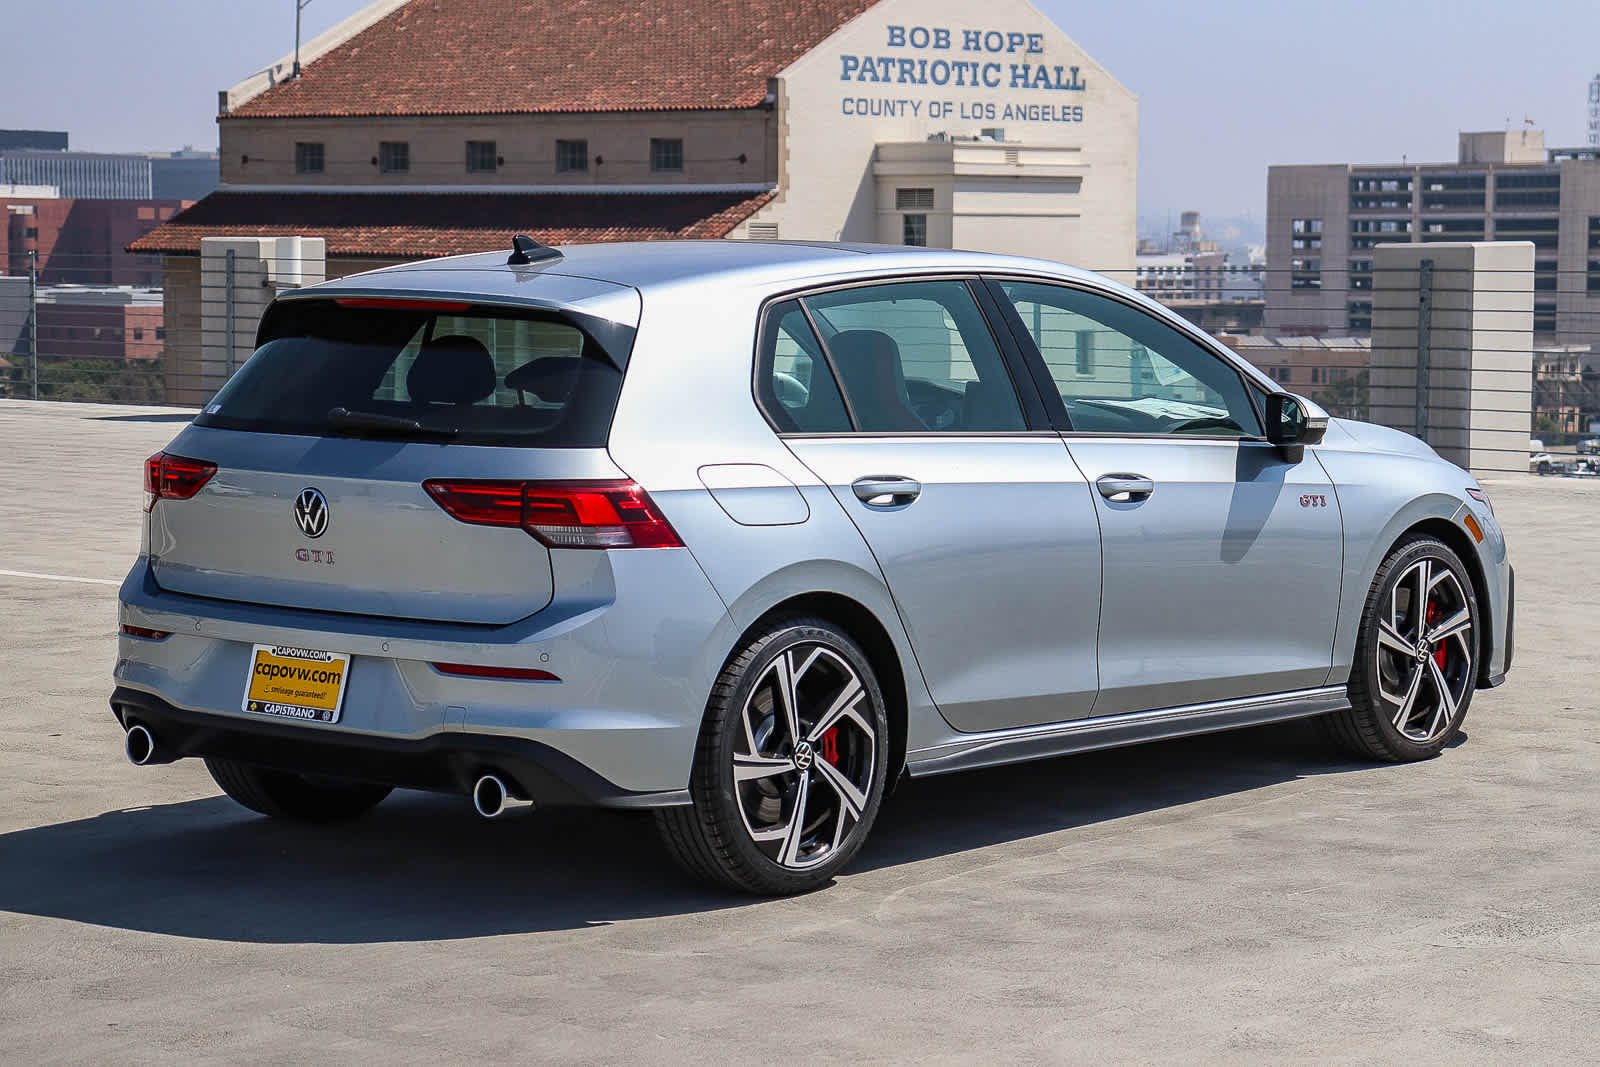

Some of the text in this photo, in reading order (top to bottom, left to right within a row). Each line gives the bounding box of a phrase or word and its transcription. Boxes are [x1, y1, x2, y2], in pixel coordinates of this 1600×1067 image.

[887, 25, 1044, 53] BOB HOPE
[840, 54, 1086, 91] PATRIOTIC HALL
[842, 97, 1084, 123] COUNTY OF LOS ANGELES
[1299, 494, 1327, 507] GTI
[295, 548, 335, 565] GTI
[277, 646, 327, 661] CAPOVW.COM
[255, 662, 341, 685] capovw.com
[264, 703, 315, 719] CAPISTRANO
